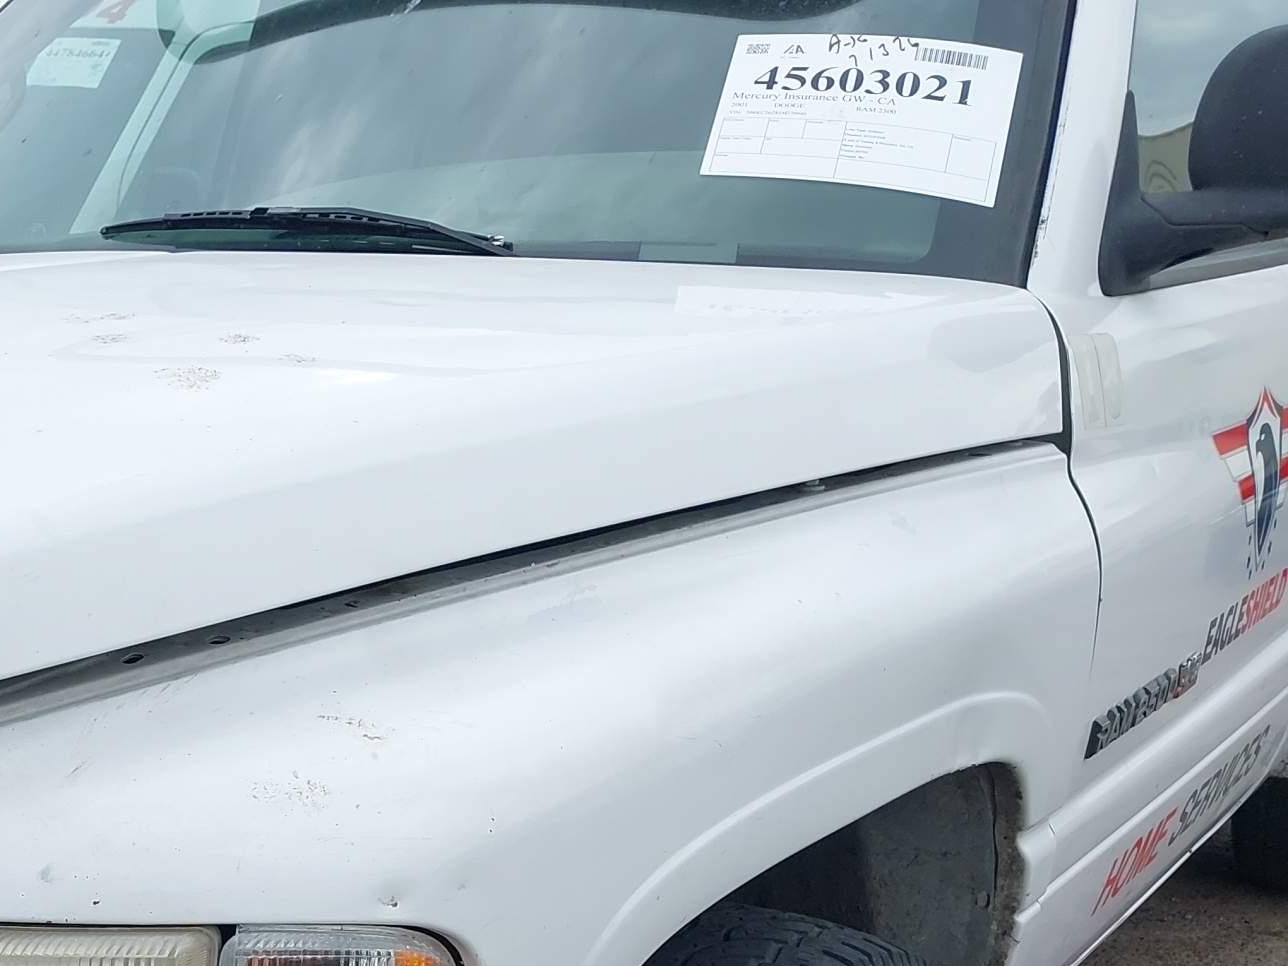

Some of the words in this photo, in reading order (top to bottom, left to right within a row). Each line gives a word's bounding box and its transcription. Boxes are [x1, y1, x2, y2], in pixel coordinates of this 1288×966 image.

[732, 91, 780, 102] Mercury
[783, 92, 839, 103] Insurance
[877, 97, 897, 107] CA
[754, 66, 974, 106] 45603021
[1091, 806, 1178, 918] HOME
